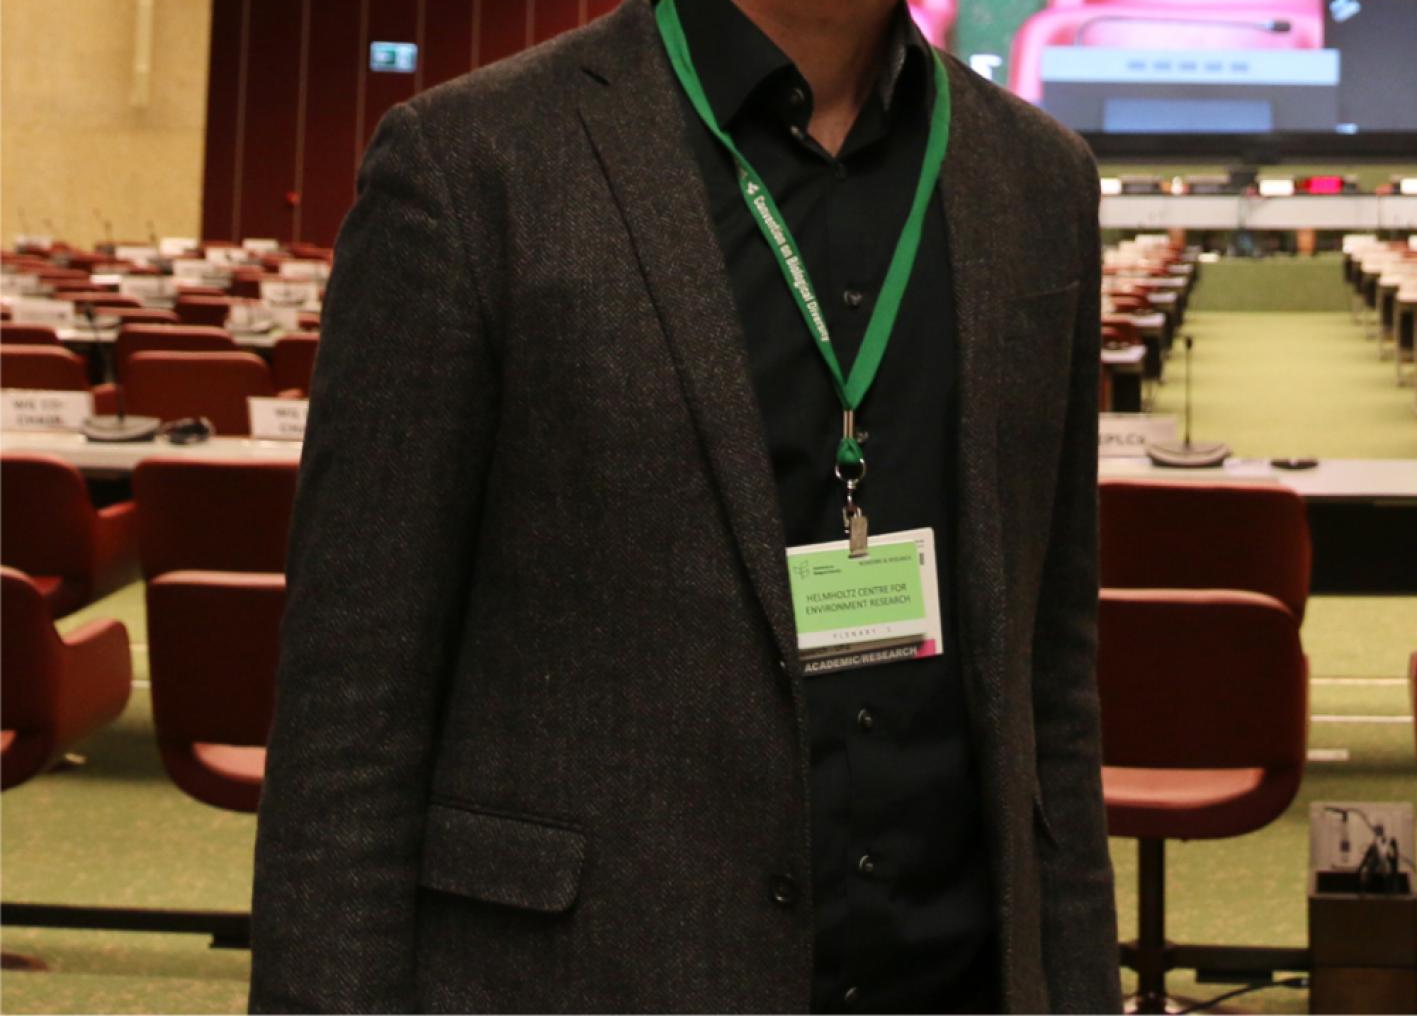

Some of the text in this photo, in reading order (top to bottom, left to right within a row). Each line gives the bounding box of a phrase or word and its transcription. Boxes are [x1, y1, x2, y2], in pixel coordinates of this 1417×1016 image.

[754, 195, 830, 341] Convention on Biological Diversity
[806, 583, 907, 602] HELMHOLTZ CENTRE FOR
[805, 594, 911, 615] ENVIRONMENT RESEARCH
